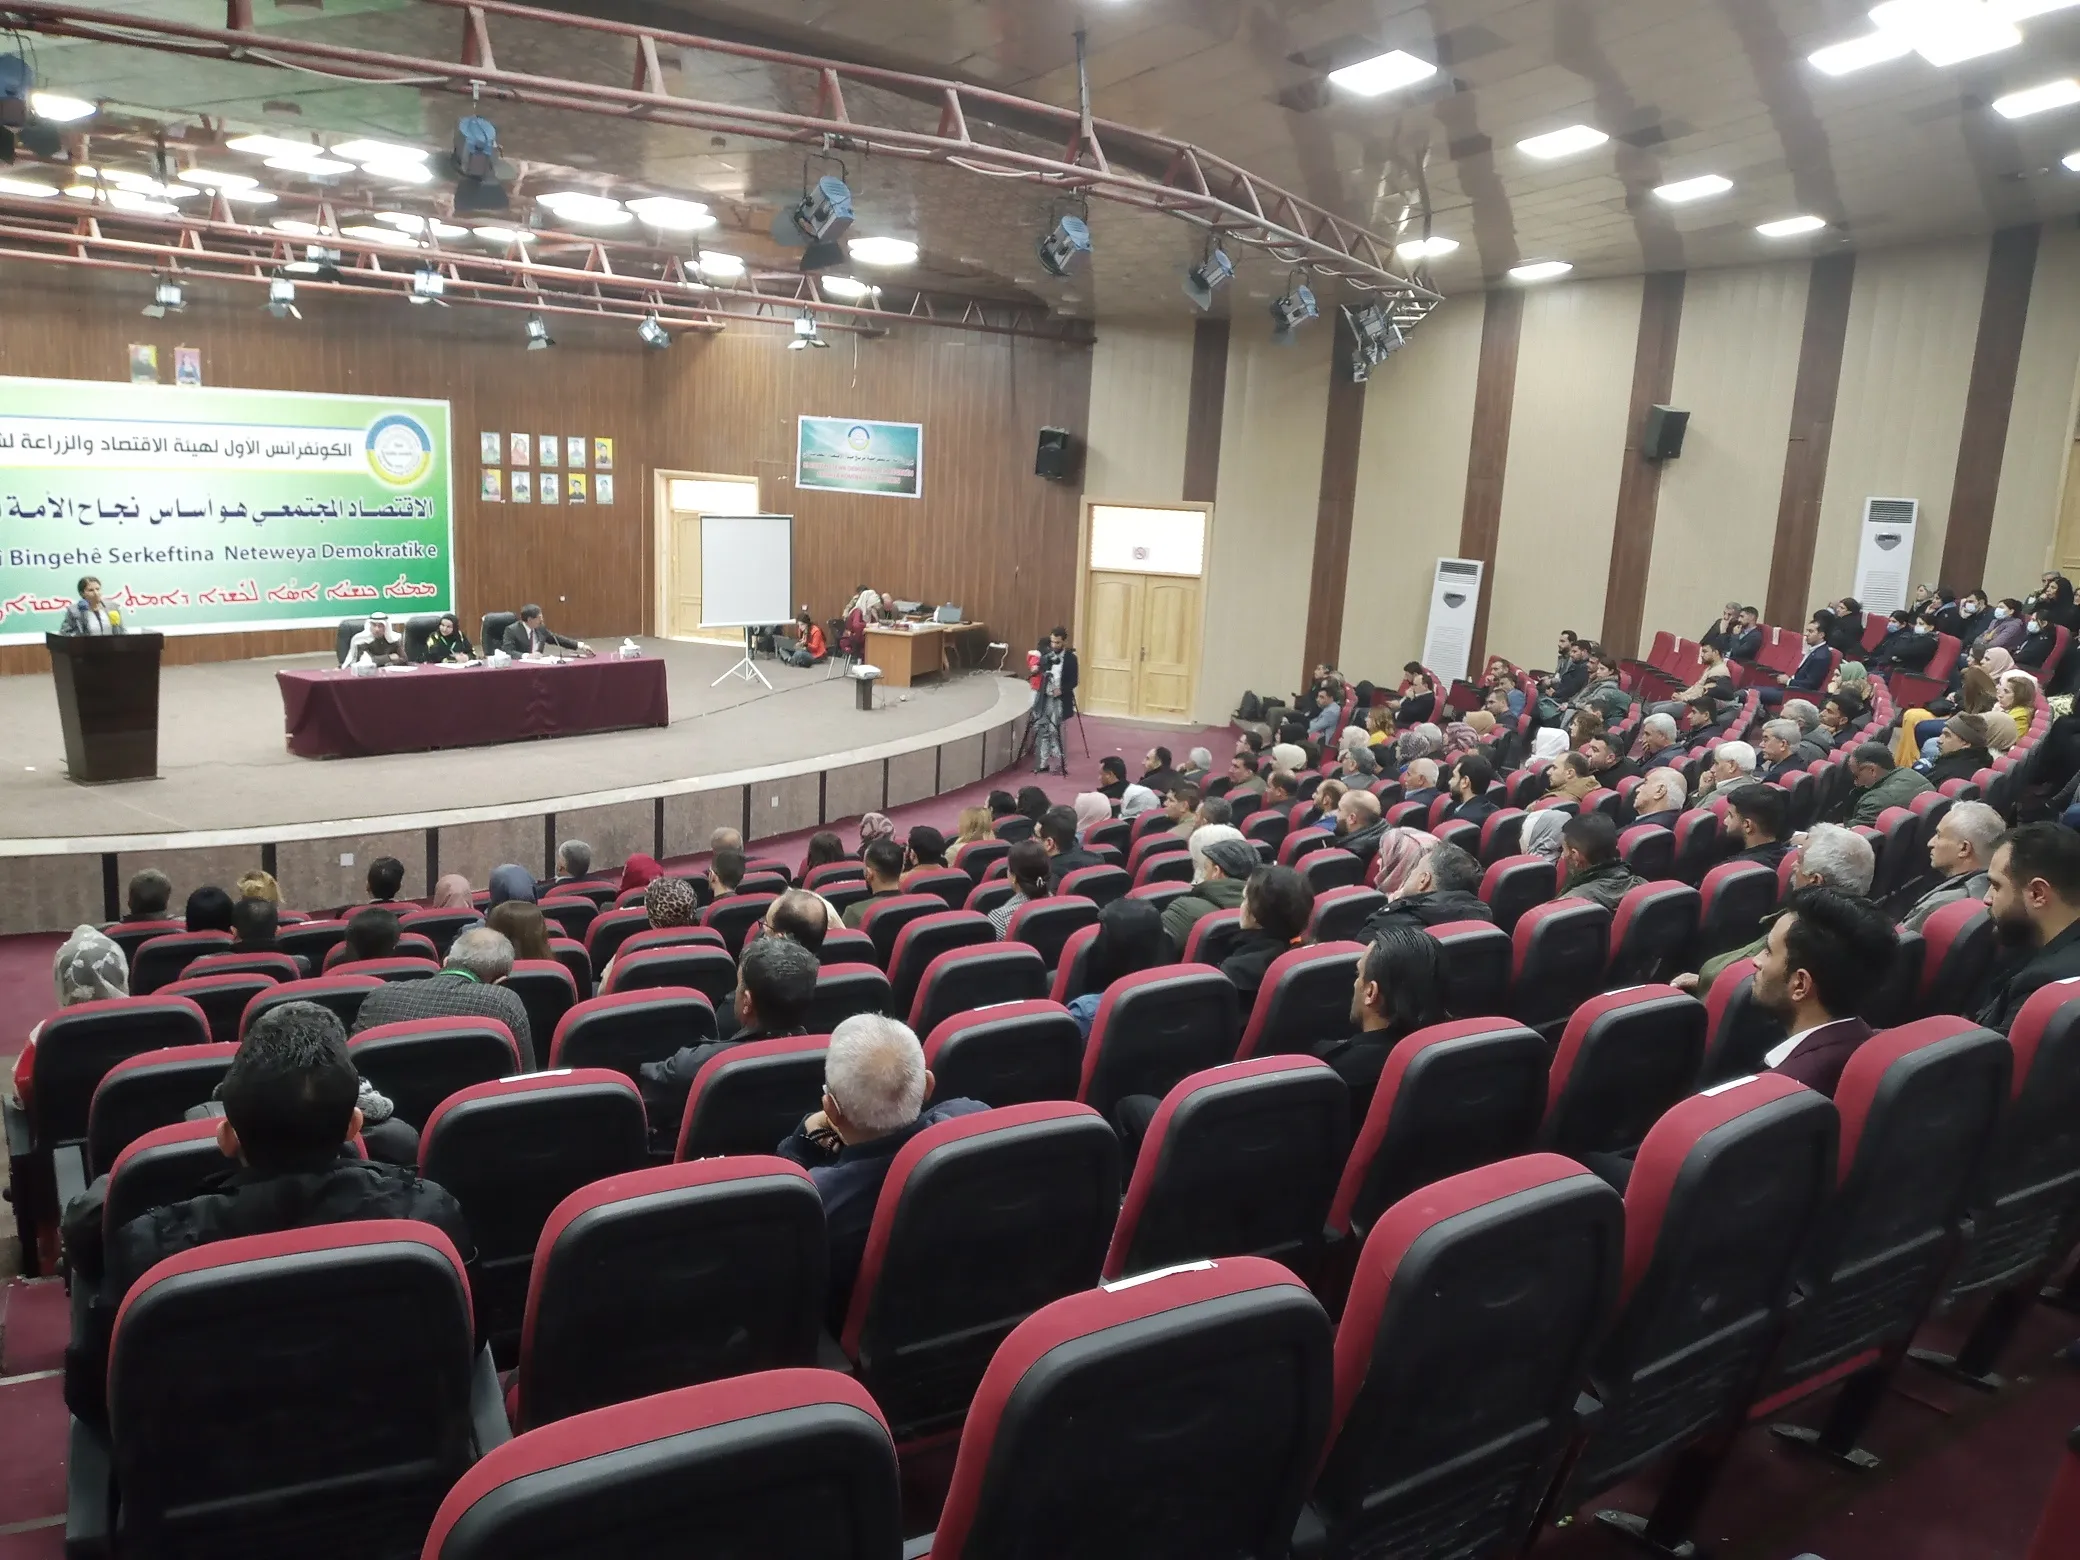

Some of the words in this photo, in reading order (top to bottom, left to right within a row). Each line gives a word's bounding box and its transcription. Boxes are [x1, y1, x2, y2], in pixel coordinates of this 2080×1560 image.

[21, 432, 94, 456] والزراعة
[101, 436, 168, 453] الاقتصاد
[266, 441, 352, 461] الكونفرانس
[78, 496, 140, 526] نجاح
[218, 501, 248, 524] هو
[251, 497, 344, 527] المجتمعي
[348, 496, 434, 518] الاقتصاد
[10, 547, 102, 570] Bingehê
[109, 545, 215, 565] Serkeftina
[225, 545, 316, 563] Neteweya
